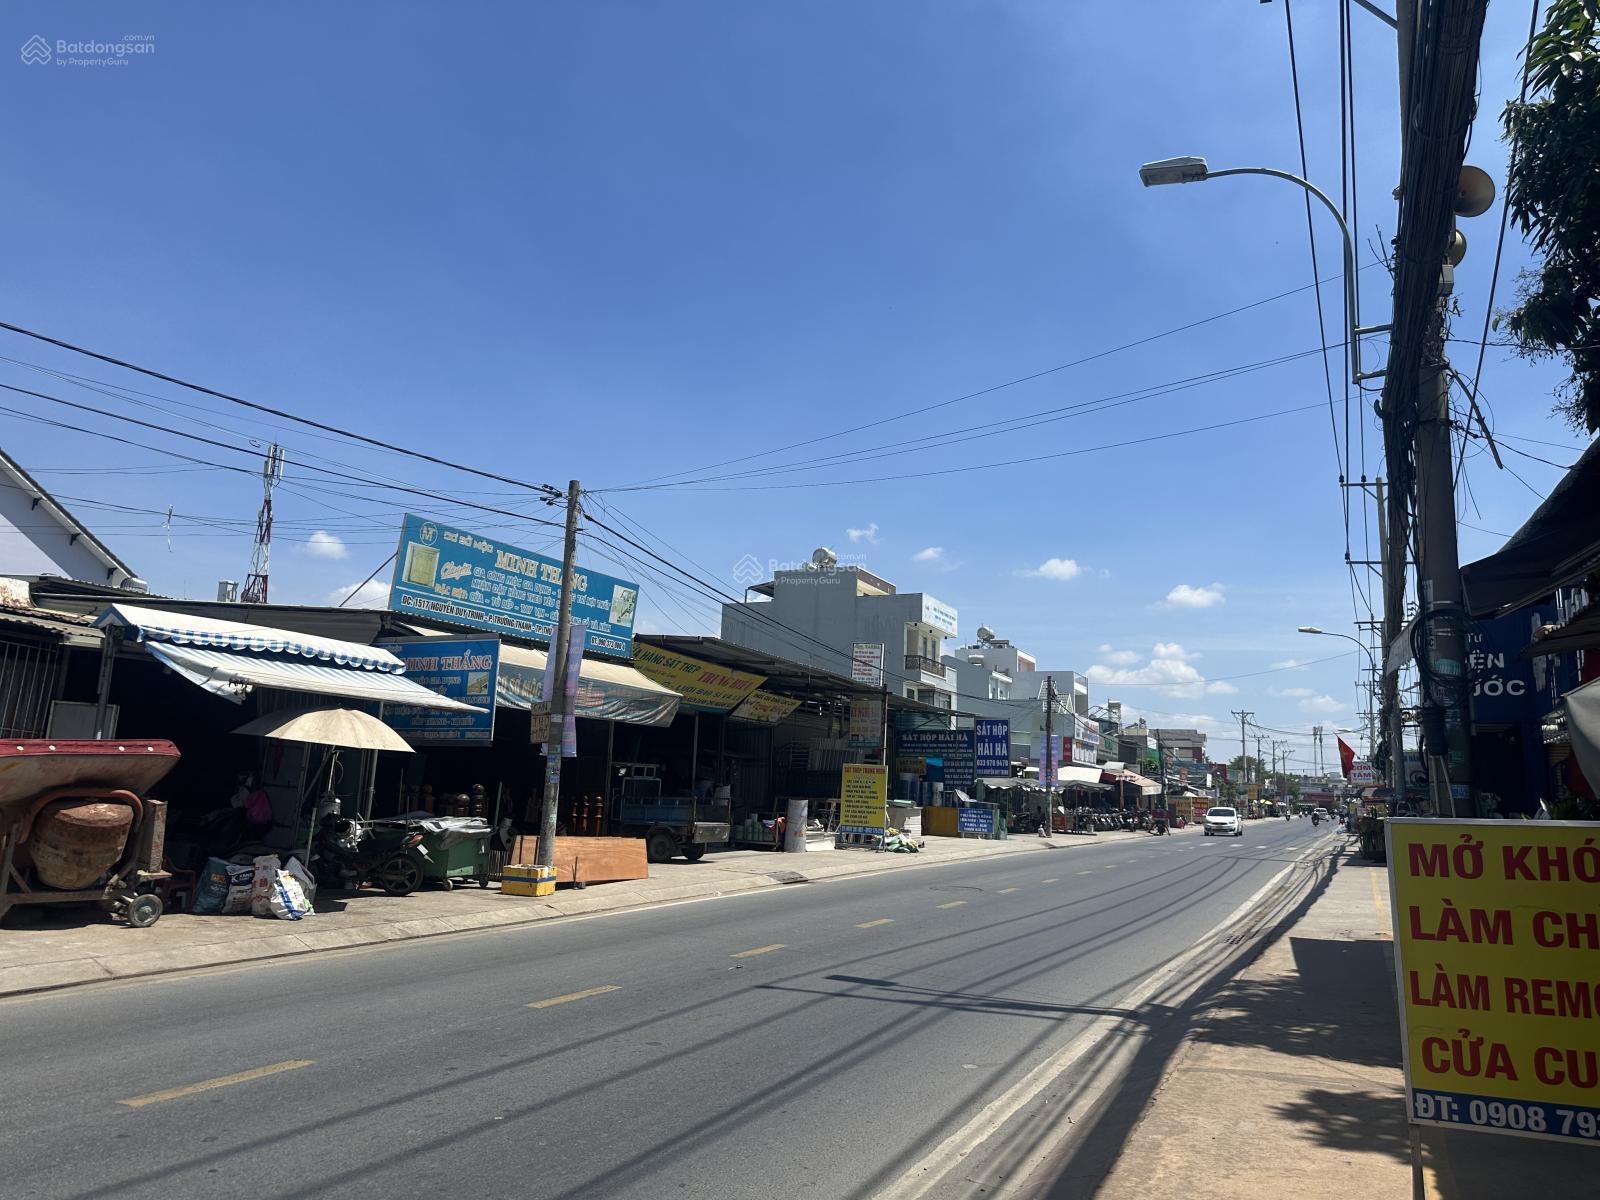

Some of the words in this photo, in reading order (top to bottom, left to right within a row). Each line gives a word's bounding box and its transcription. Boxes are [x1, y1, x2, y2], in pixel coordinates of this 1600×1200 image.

[495, 549, 539, 578] MINH
[541, 566, 588, 593] THNG
[640, 650, 666, 665] HÀNG
[977, 721, 991, 736] SẮT
[992, 723, 1008, 738] HỘP
[977, 739, 993, 756] HẢI
[994, 740, 1008, 756] HÀ
[1407, 833, 1485, 882] MỞ
[1408, 897, 1515, 946] LÀM
[1408, 963, 1491, 1012] LÀM
[1503, 977, 1600, 1020] REM
[1420, 1028, 1520, 1082] CỬA
[1414, 1092, 1461, 1122] ĐT:
[1469, 1099, 1547, 1132] 0908
[1555, 1109, 1600, 1138] 79
